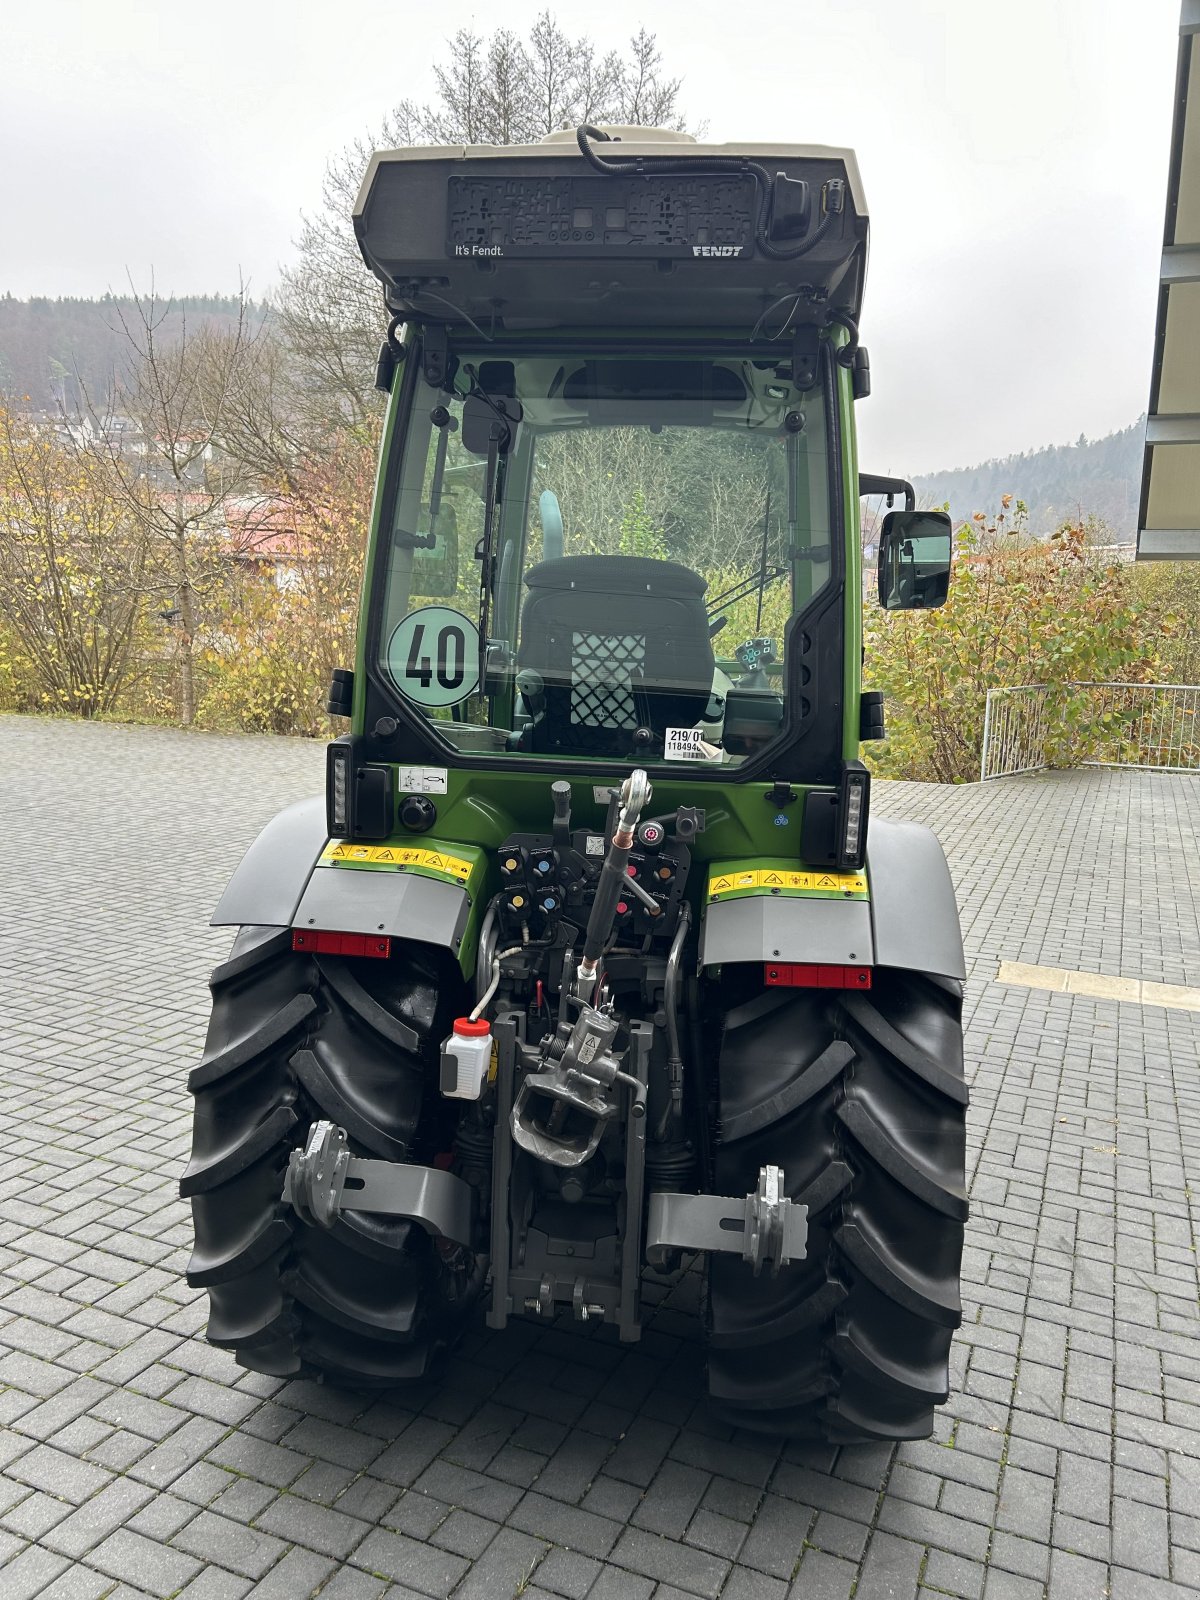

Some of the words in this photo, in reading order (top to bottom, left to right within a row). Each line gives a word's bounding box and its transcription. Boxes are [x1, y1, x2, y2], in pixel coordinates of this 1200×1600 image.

[455, 244, 470, 256] It's
[472, 244, 504, 256] Fendt.
[692, 246, 744, 257] FENDT
[405, 624, 465, 690] 40
